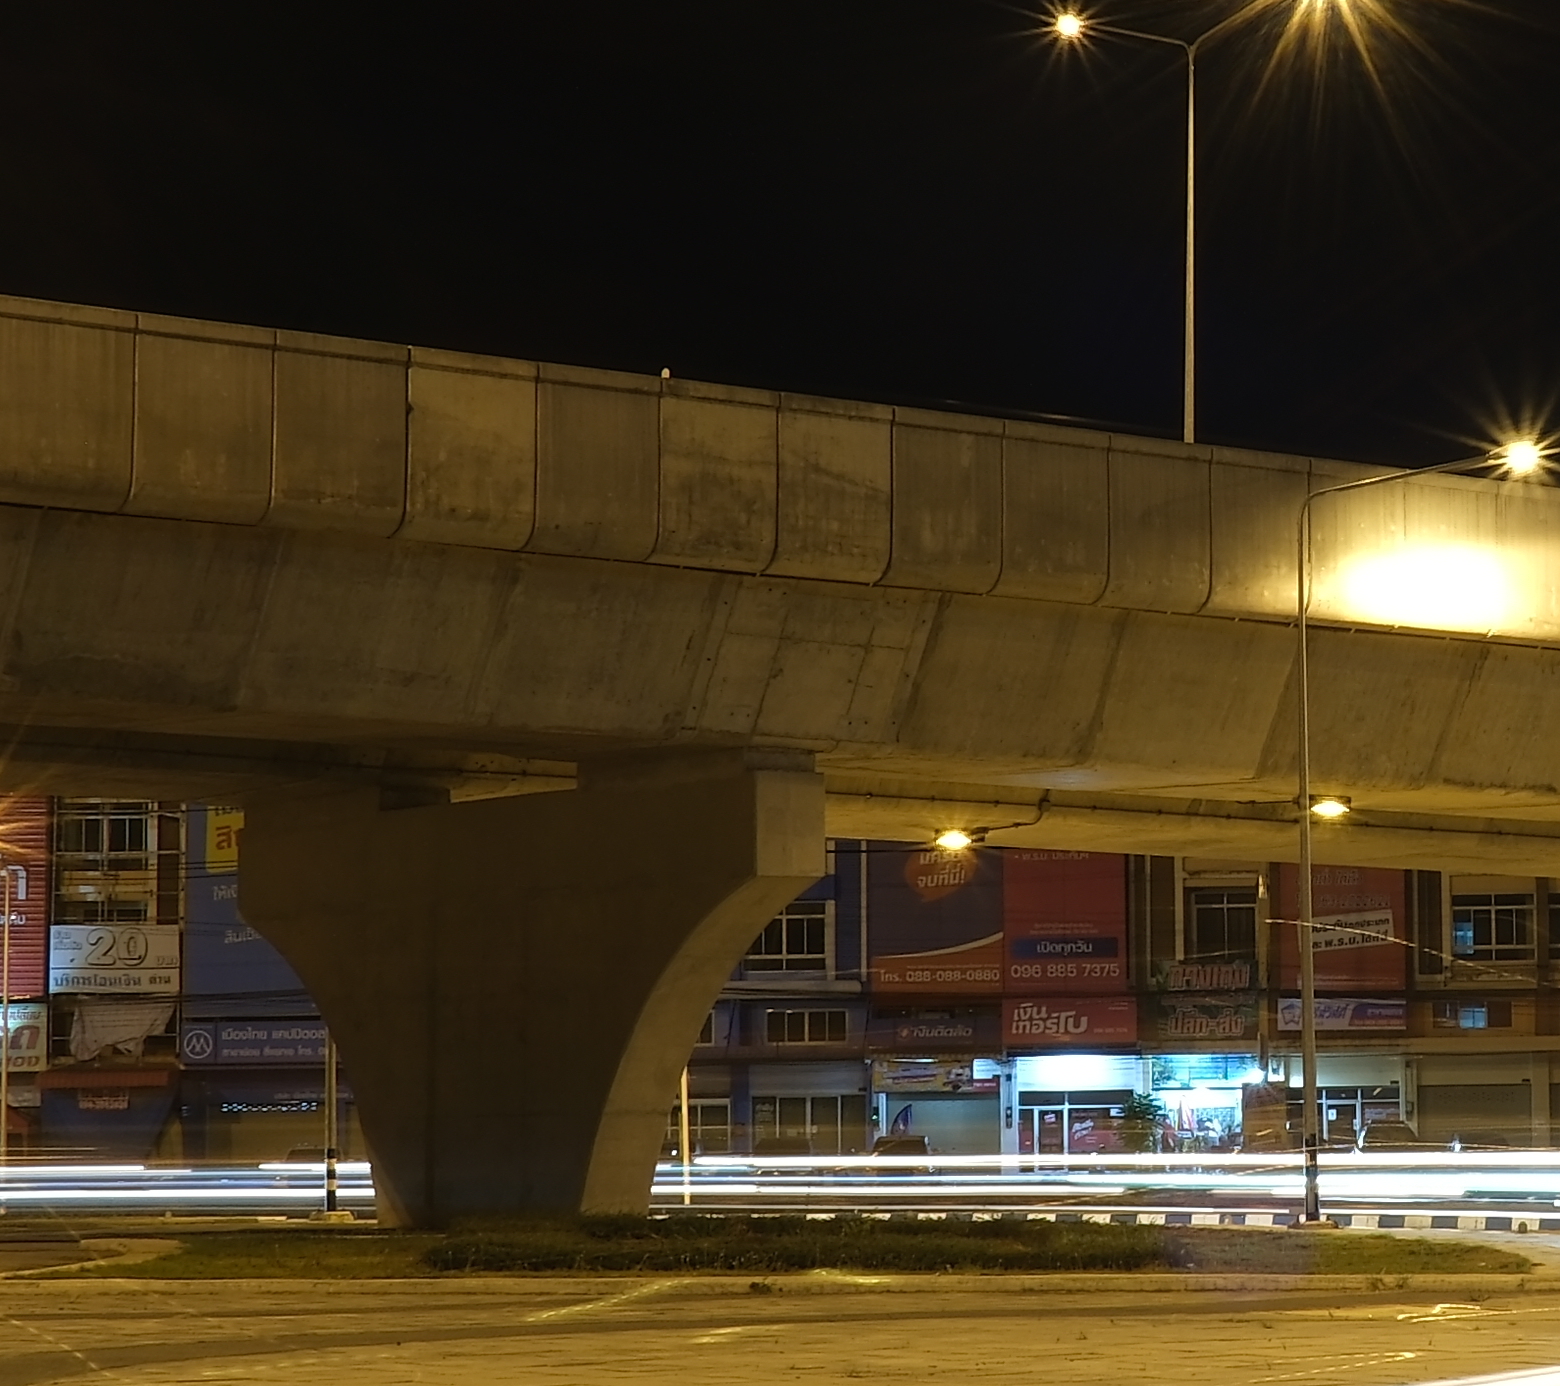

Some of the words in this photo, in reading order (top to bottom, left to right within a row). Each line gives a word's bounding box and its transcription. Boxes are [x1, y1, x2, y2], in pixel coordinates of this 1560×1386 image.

[85, 927, 148, 967] 20
[1036, 939, 1093, 956] เปิดทุกวัน
[906, 970, 1000, 983] 088-088-0880
[1010, 963, 1042, 978] 096
[1046, 963, 1078, 978] 885
[1082, 963, 1120, 978] 7375
[1013, 1003, 1048, 1021] เงิน
[1011, 1011, 1089, 1034] เทอร์โบ
[222, 1027, 267, 1040] เมืองไทย
